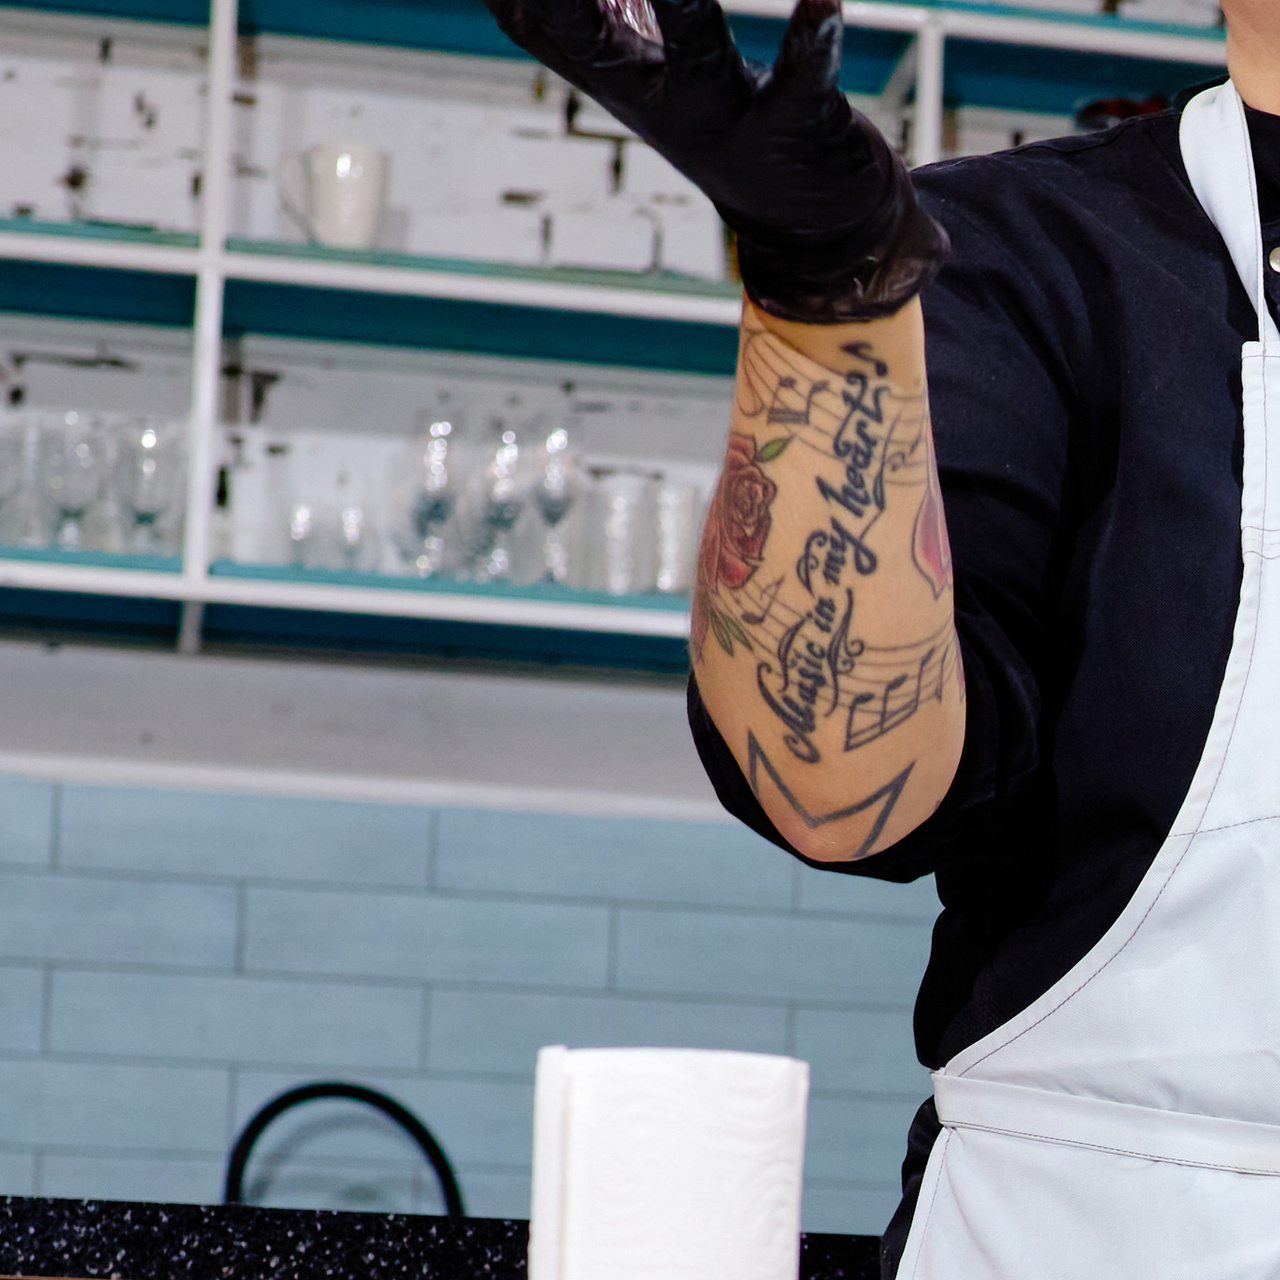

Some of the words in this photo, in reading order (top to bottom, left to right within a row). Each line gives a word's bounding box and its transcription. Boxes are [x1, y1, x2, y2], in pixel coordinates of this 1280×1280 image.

[815, 372, 891, 518] heart
[822, 516, 878, 587] my
[806, 596, 837, 633] in
[756, 642, 828, 765] Music
